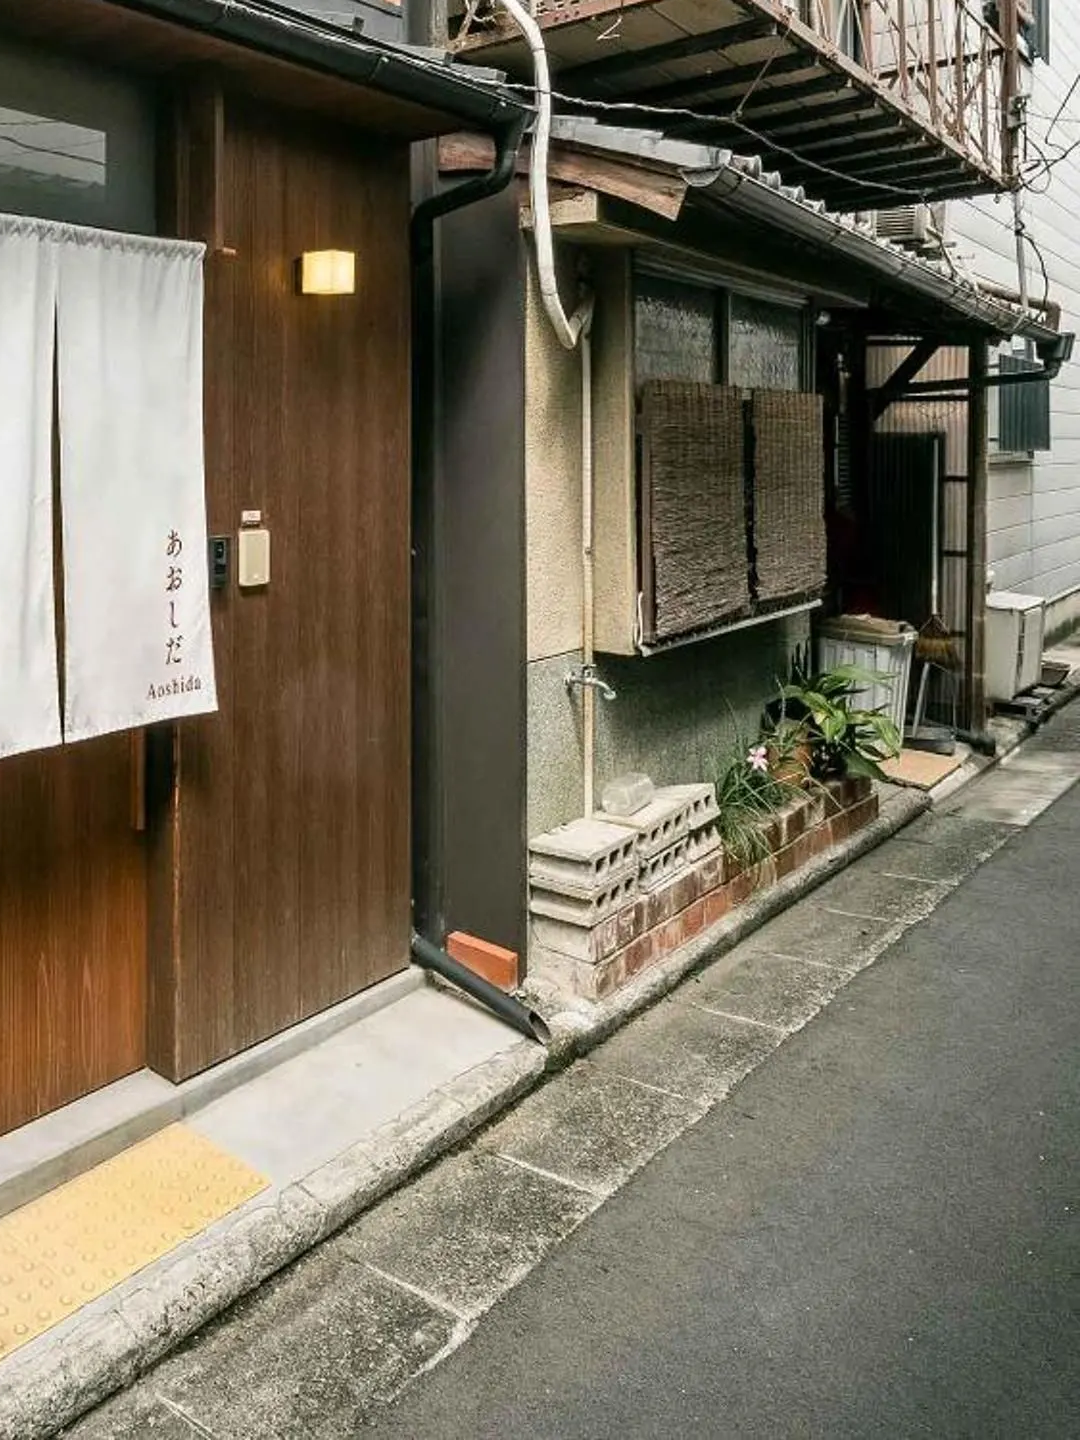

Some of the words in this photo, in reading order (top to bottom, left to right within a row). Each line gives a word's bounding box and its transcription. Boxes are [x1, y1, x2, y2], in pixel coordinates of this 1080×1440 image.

[165, 528, 184, 665] あおしだ
[146, 675, 202, 700] Aoshida
